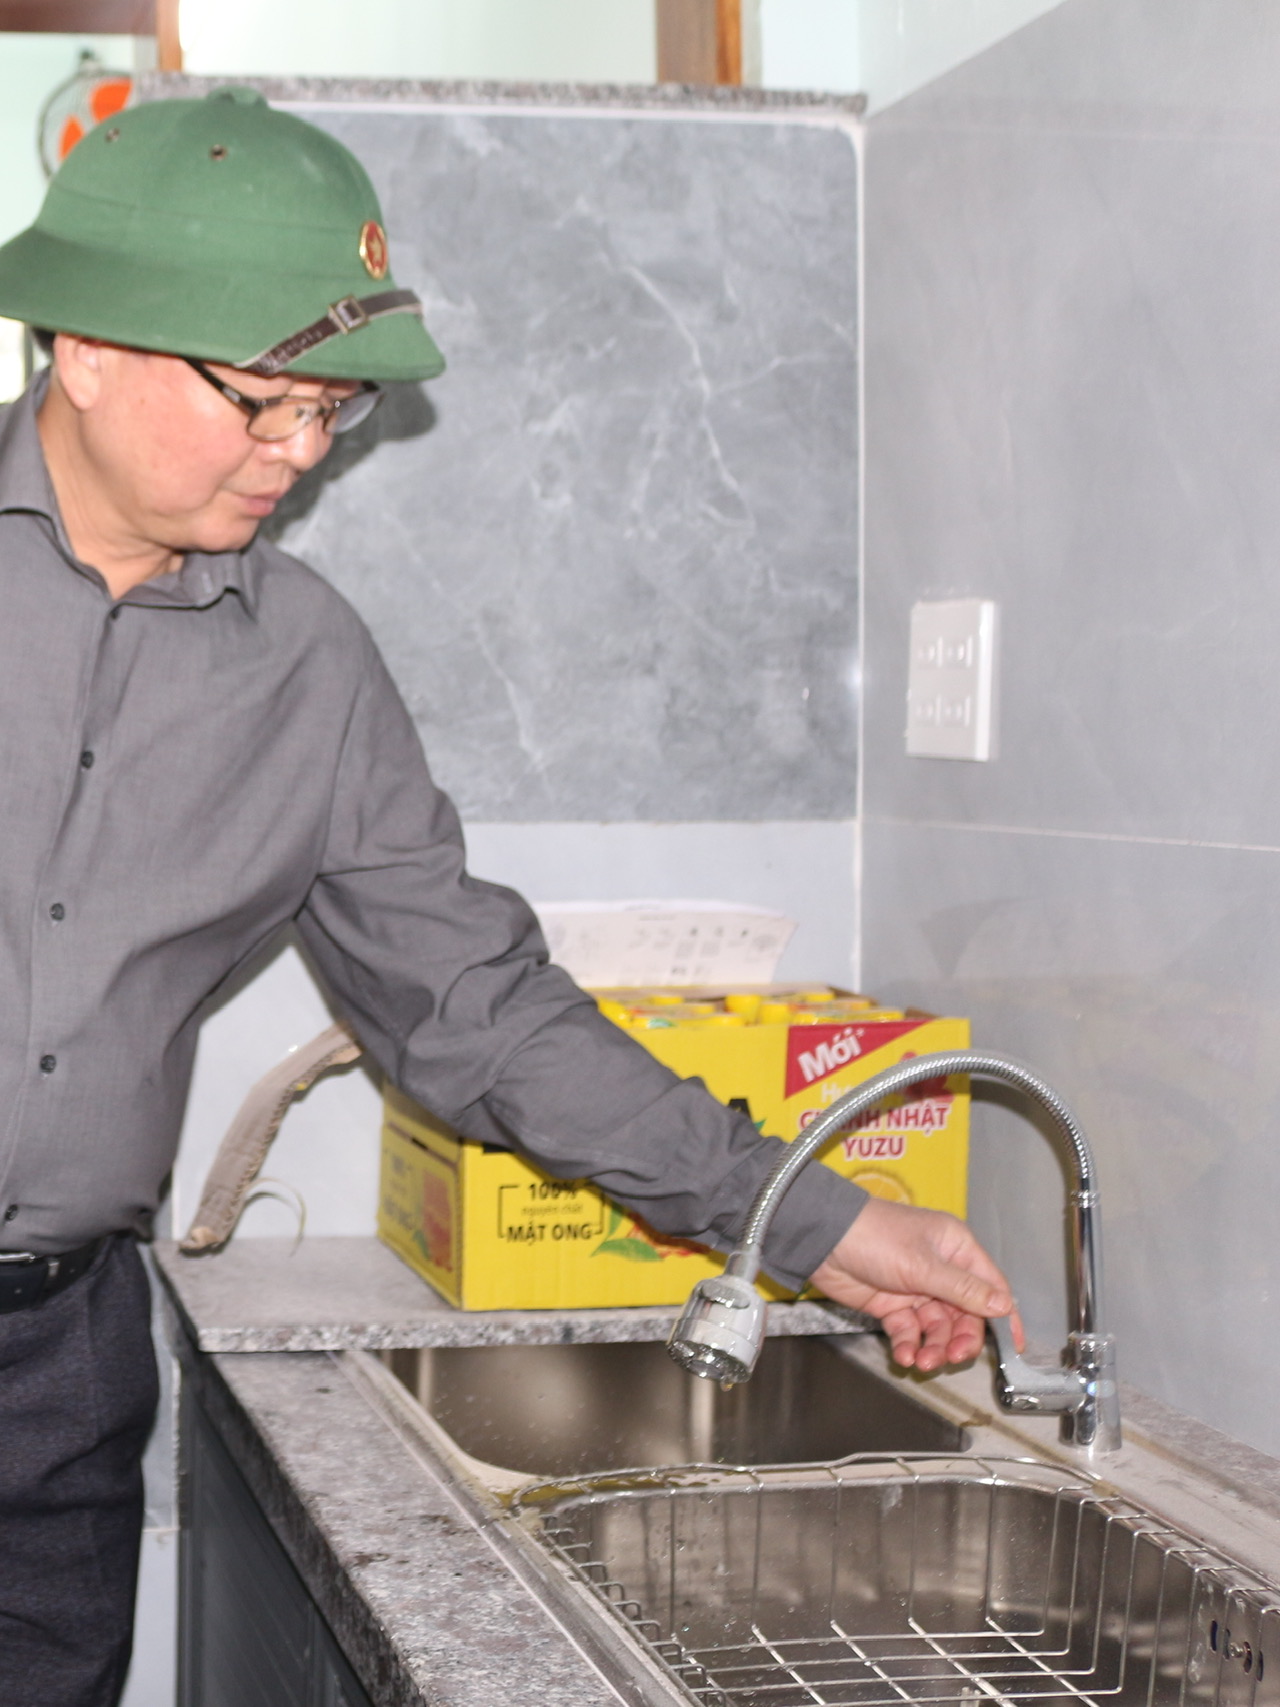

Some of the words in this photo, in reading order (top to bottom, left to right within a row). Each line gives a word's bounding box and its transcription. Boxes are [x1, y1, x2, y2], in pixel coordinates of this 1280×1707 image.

[886, 1101, 950, 1135] NHẬT
[842, 1135, 905, 1160] YUZU
[506, 1219, 547, 1246] MẬT
[551, 1222, 593, 1241] ONG
